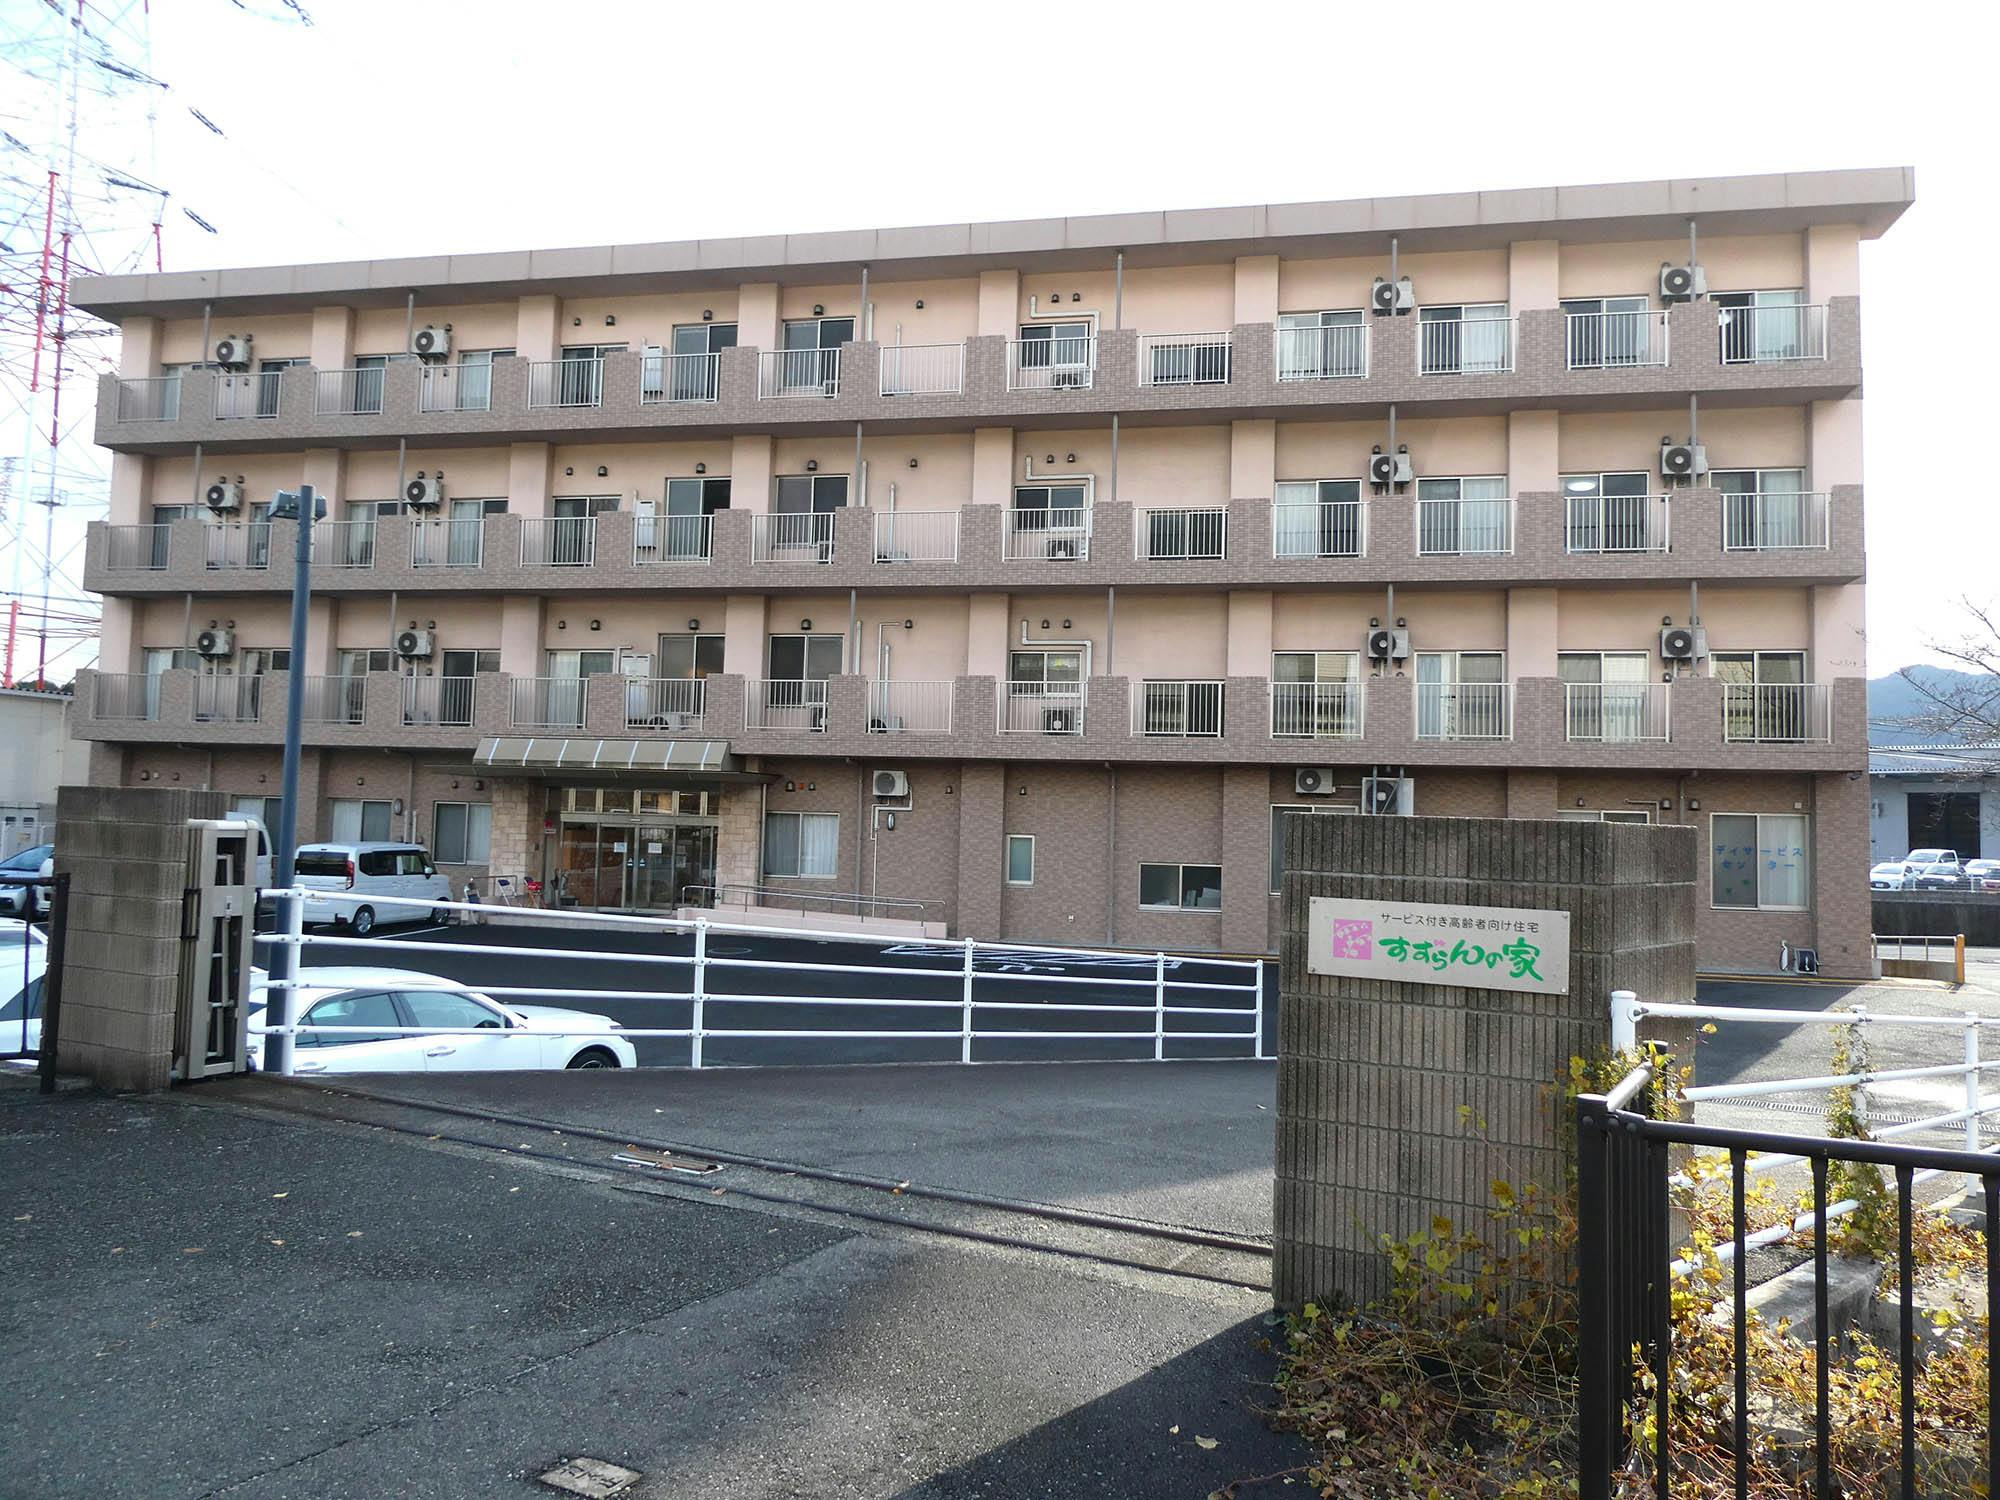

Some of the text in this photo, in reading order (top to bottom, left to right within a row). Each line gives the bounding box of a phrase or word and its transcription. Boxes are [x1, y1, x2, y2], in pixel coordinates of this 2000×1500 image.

[1381, 912, 1540, 934] サービス付き高齢者向け住宅
[1378, 935, 1544, 982] すずらんの家
